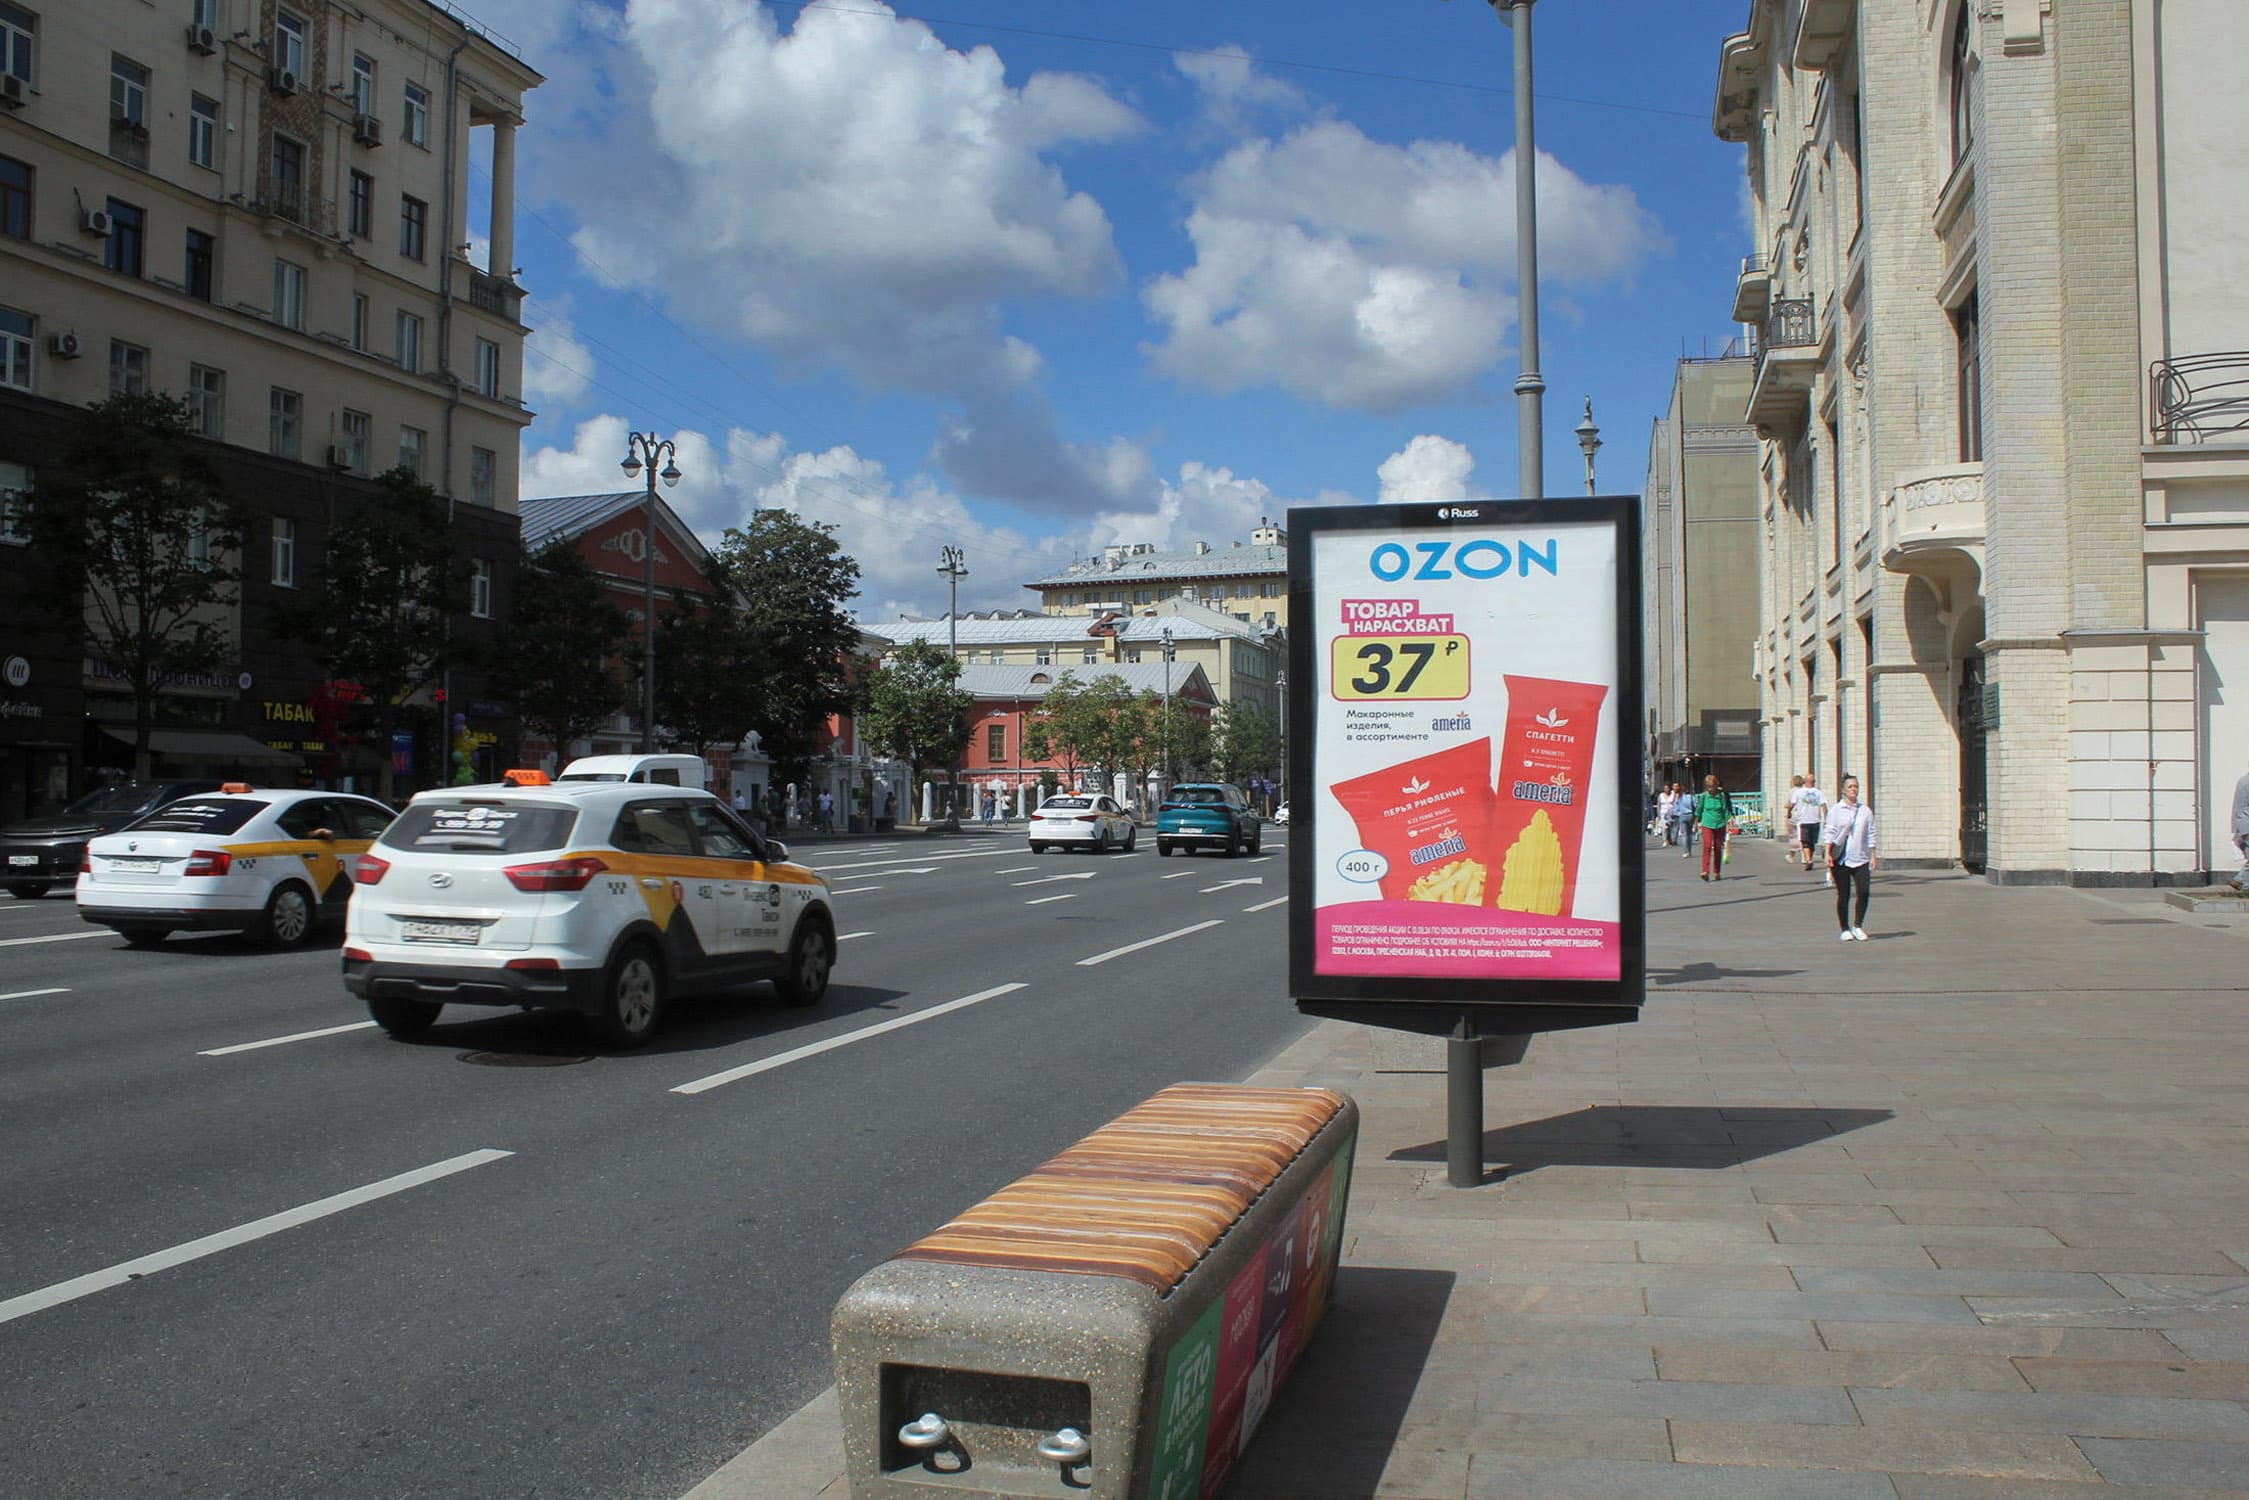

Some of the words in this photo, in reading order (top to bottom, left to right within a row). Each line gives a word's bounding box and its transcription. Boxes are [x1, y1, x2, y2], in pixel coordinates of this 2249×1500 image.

[1451, 508, 1479, 518] Russ
[1370, 538, 1558, 582] OZON
[1345, 602, 1414, 619] ТОВАР
[1354, 618, 1450, 633] НАРАСХВАТ
[1351, 643, 1435, 694] 37
[264, 702, 315, 722] ТАБАК
[1346, 709, 1415, 720] Макаронные
[1346, 721, 1392, 731] изделия,
[1355, 733, 1429, 743] ассортименте
[1526, 731, 1575, 743] СПАГЕТТИ
[1383, 803, 1412, 817] ПЕРЬЯ
[1414, 786, 1465, 808] РИФЛЕНЫЕ
[1345, 862, 1370, 872] 400
[1168, 1344, 1211, 1426] ЛЕТО
